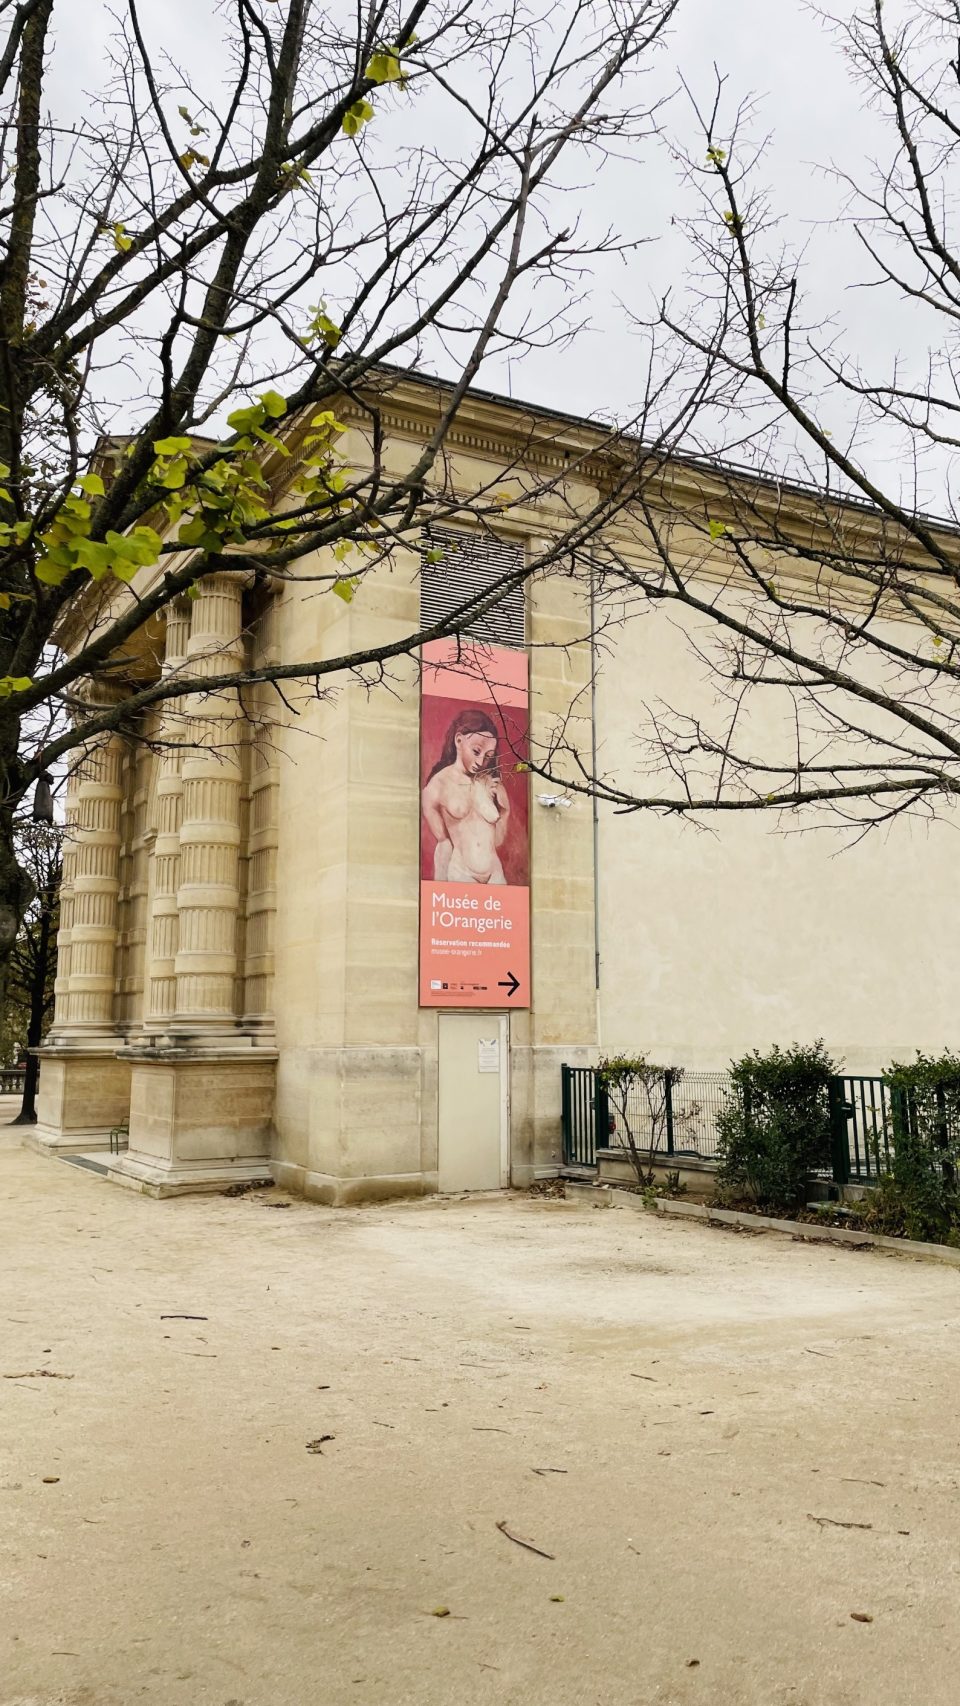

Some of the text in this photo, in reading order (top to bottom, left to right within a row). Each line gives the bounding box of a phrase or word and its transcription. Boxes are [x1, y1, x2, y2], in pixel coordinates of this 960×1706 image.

[432, 892, 501, 910] Musée de
[432, 911, 512, 933] l'Orangerie
